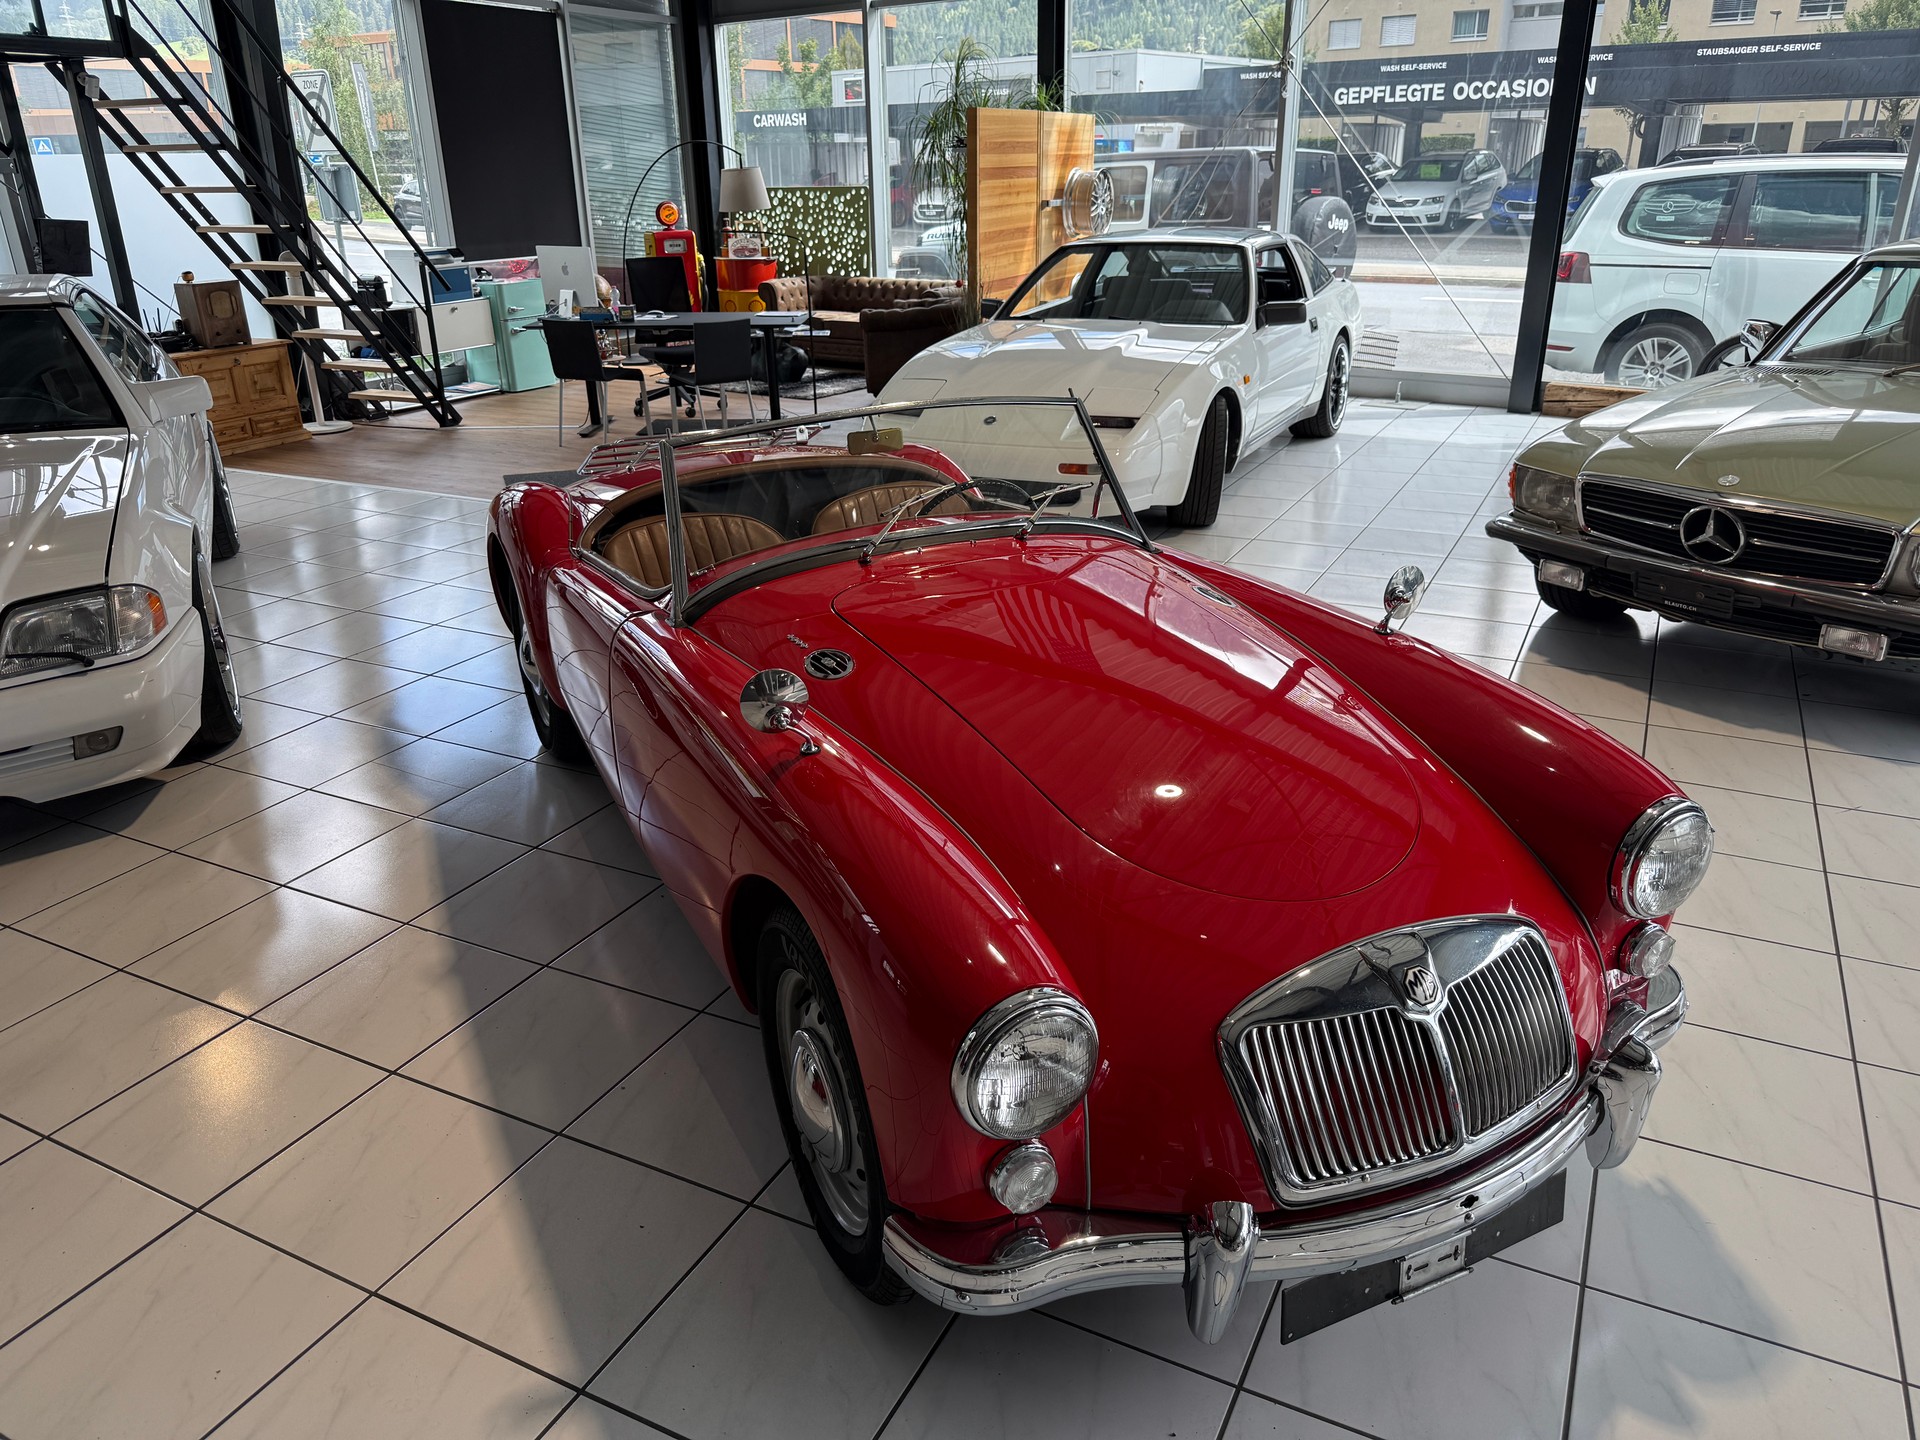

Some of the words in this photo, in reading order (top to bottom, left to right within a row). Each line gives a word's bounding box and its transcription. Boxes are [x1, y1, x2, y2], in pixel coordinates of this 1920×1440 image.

[1696, 46, 1759, 56] STAUBSAUGER
[1760, 42, 1822, 53] SELF-SERVICE
[1380, 64, 1400, 72] WASH
[1401, 62, 1448, 71] SELF-SERVICE
[1240, 72, 1258, 80] WASH
[302, 80, 319, 90] ZONE
[1333, 83, 1446, 105] GEPFLEGTE
[1452, 76, 1597, 101] OCCASION
[753, 112, 807, 128] CARWASH
[1327, 213, 1349, 234] Jeep
[1407, 968, 1438, 1002] MG
